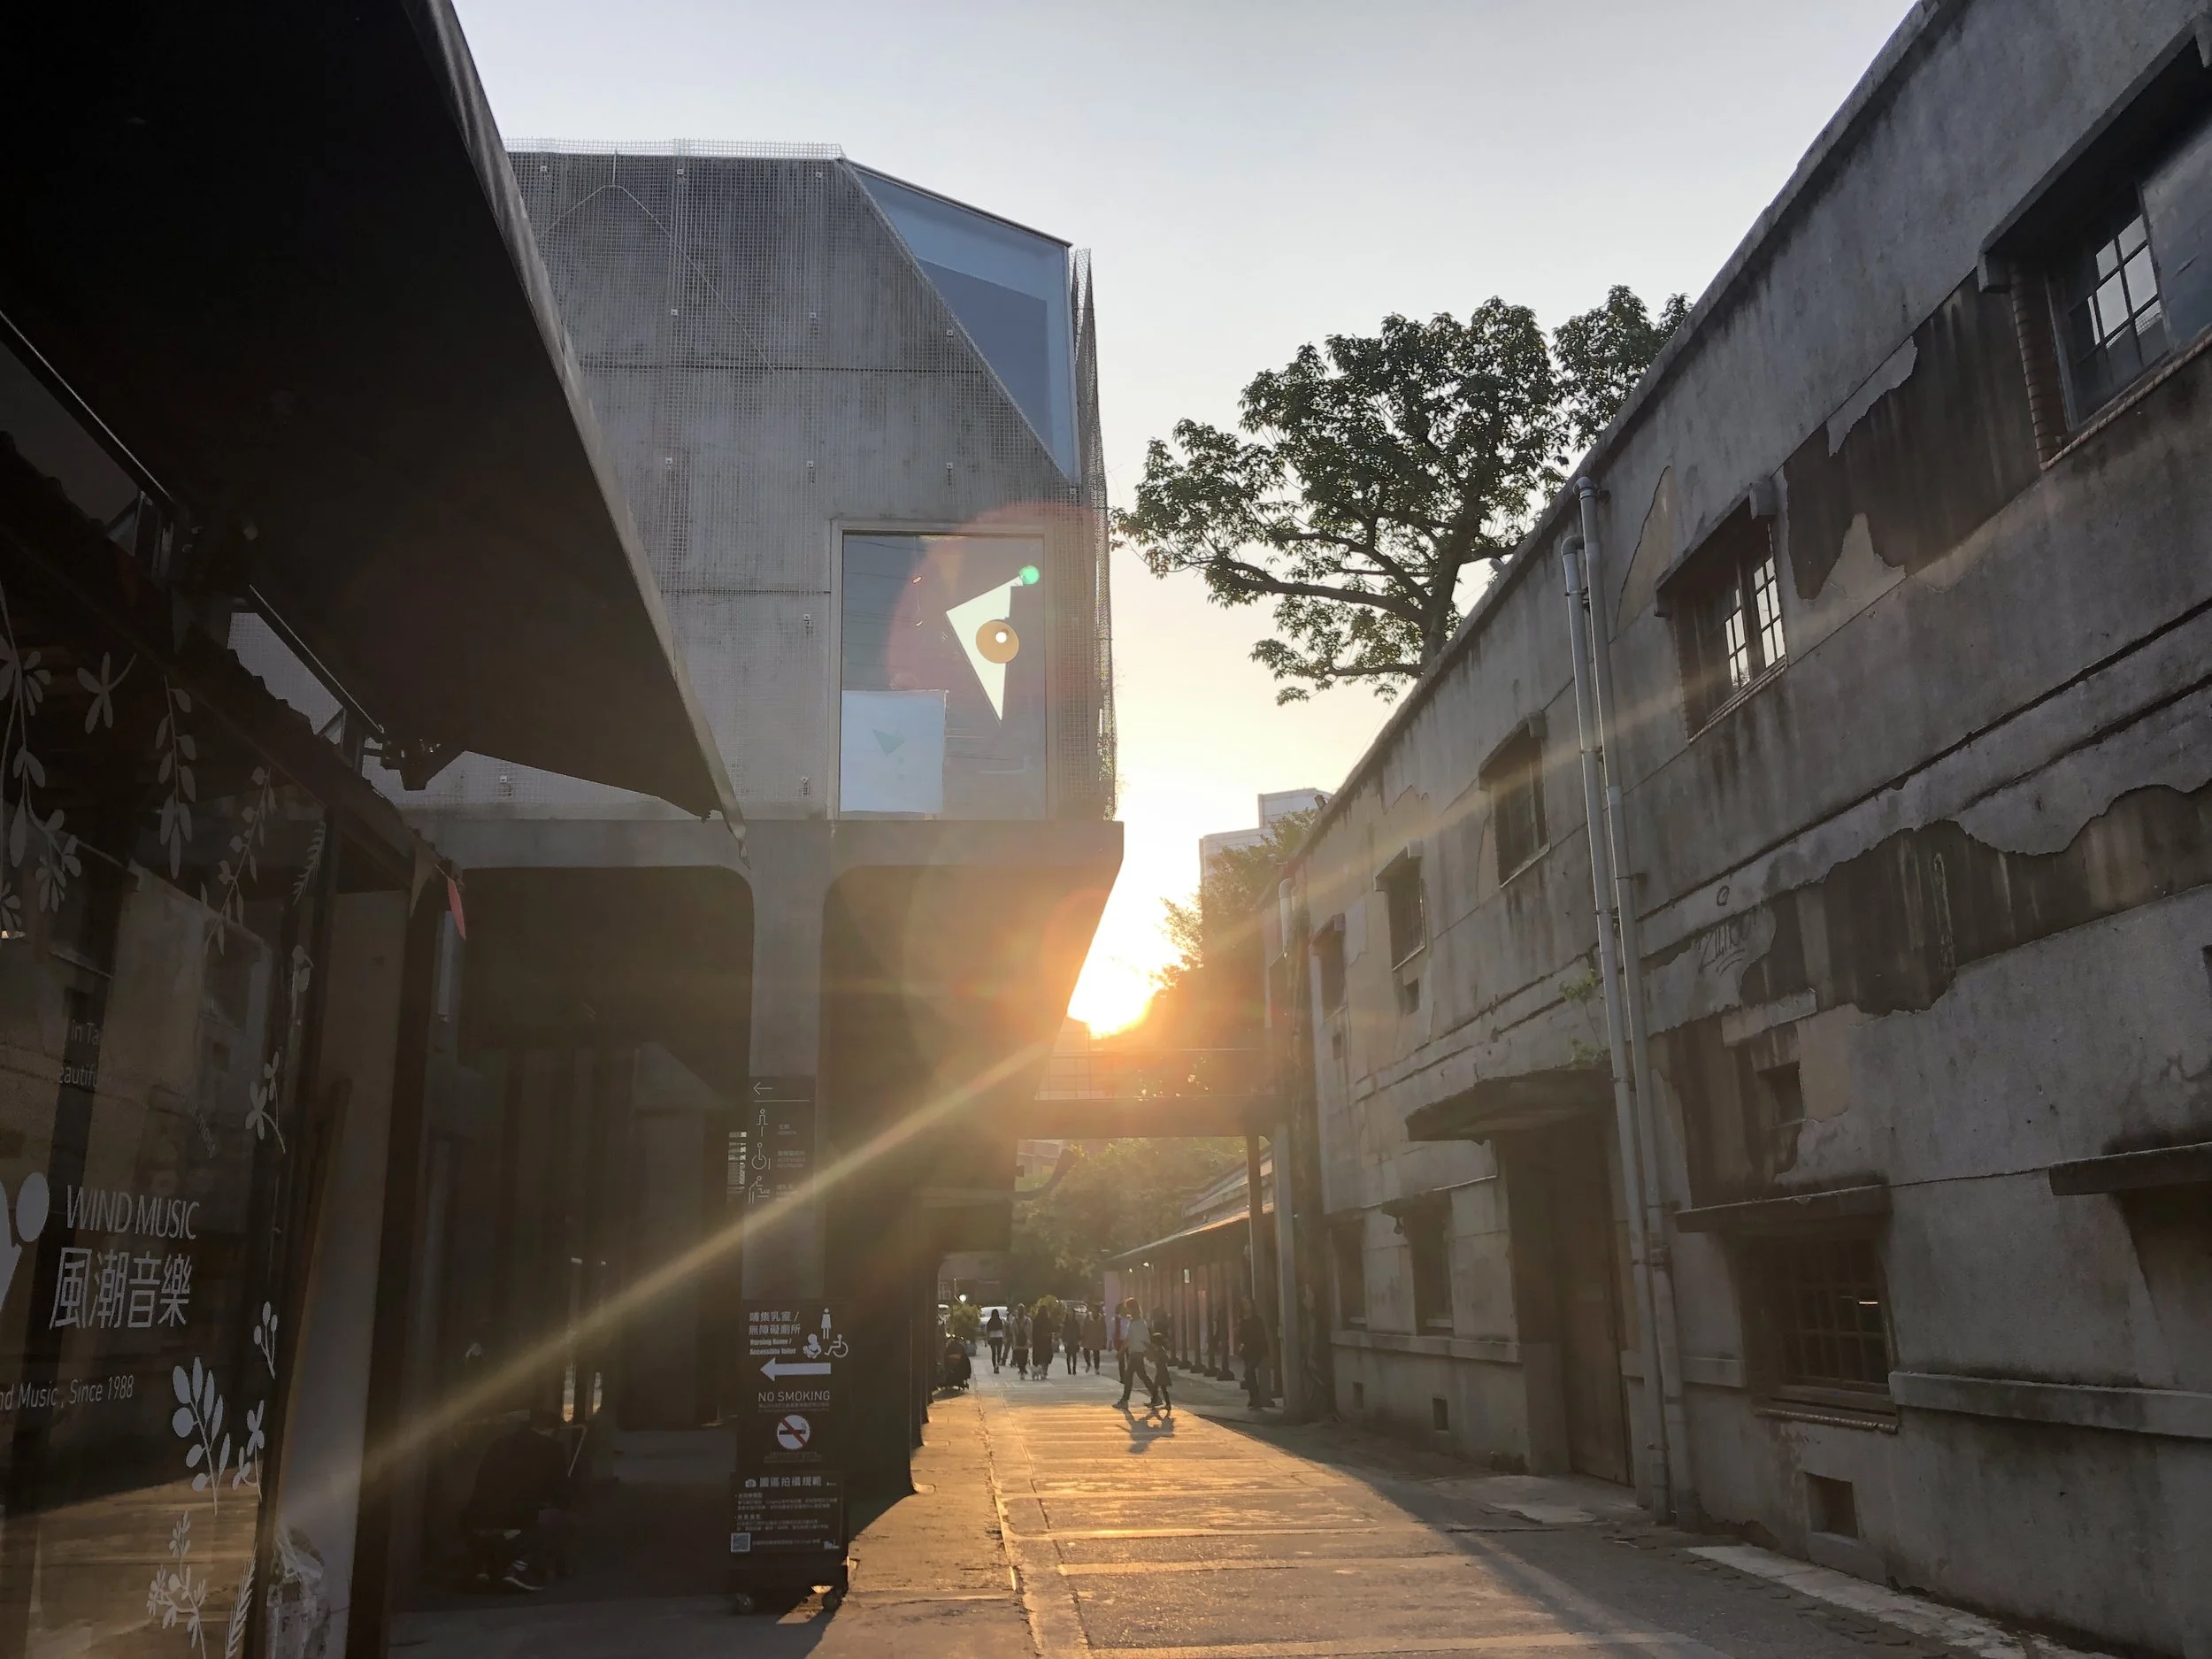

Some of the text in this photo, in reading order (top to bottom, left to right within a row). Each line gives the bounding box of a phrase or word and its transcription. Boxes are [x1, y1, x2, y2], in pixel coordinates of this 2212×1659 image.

[66, 1184, 200, 1240] WIND MUSIC
[49, 1247, 194, 1331] 風潮音樂
[0, 1383, 15, 1410] nd
[68, 1378, 104, 1405] Since
[107, 1374, 134, 1400] 1988
[757, 1390, 831, 1402] NO SMOKING
